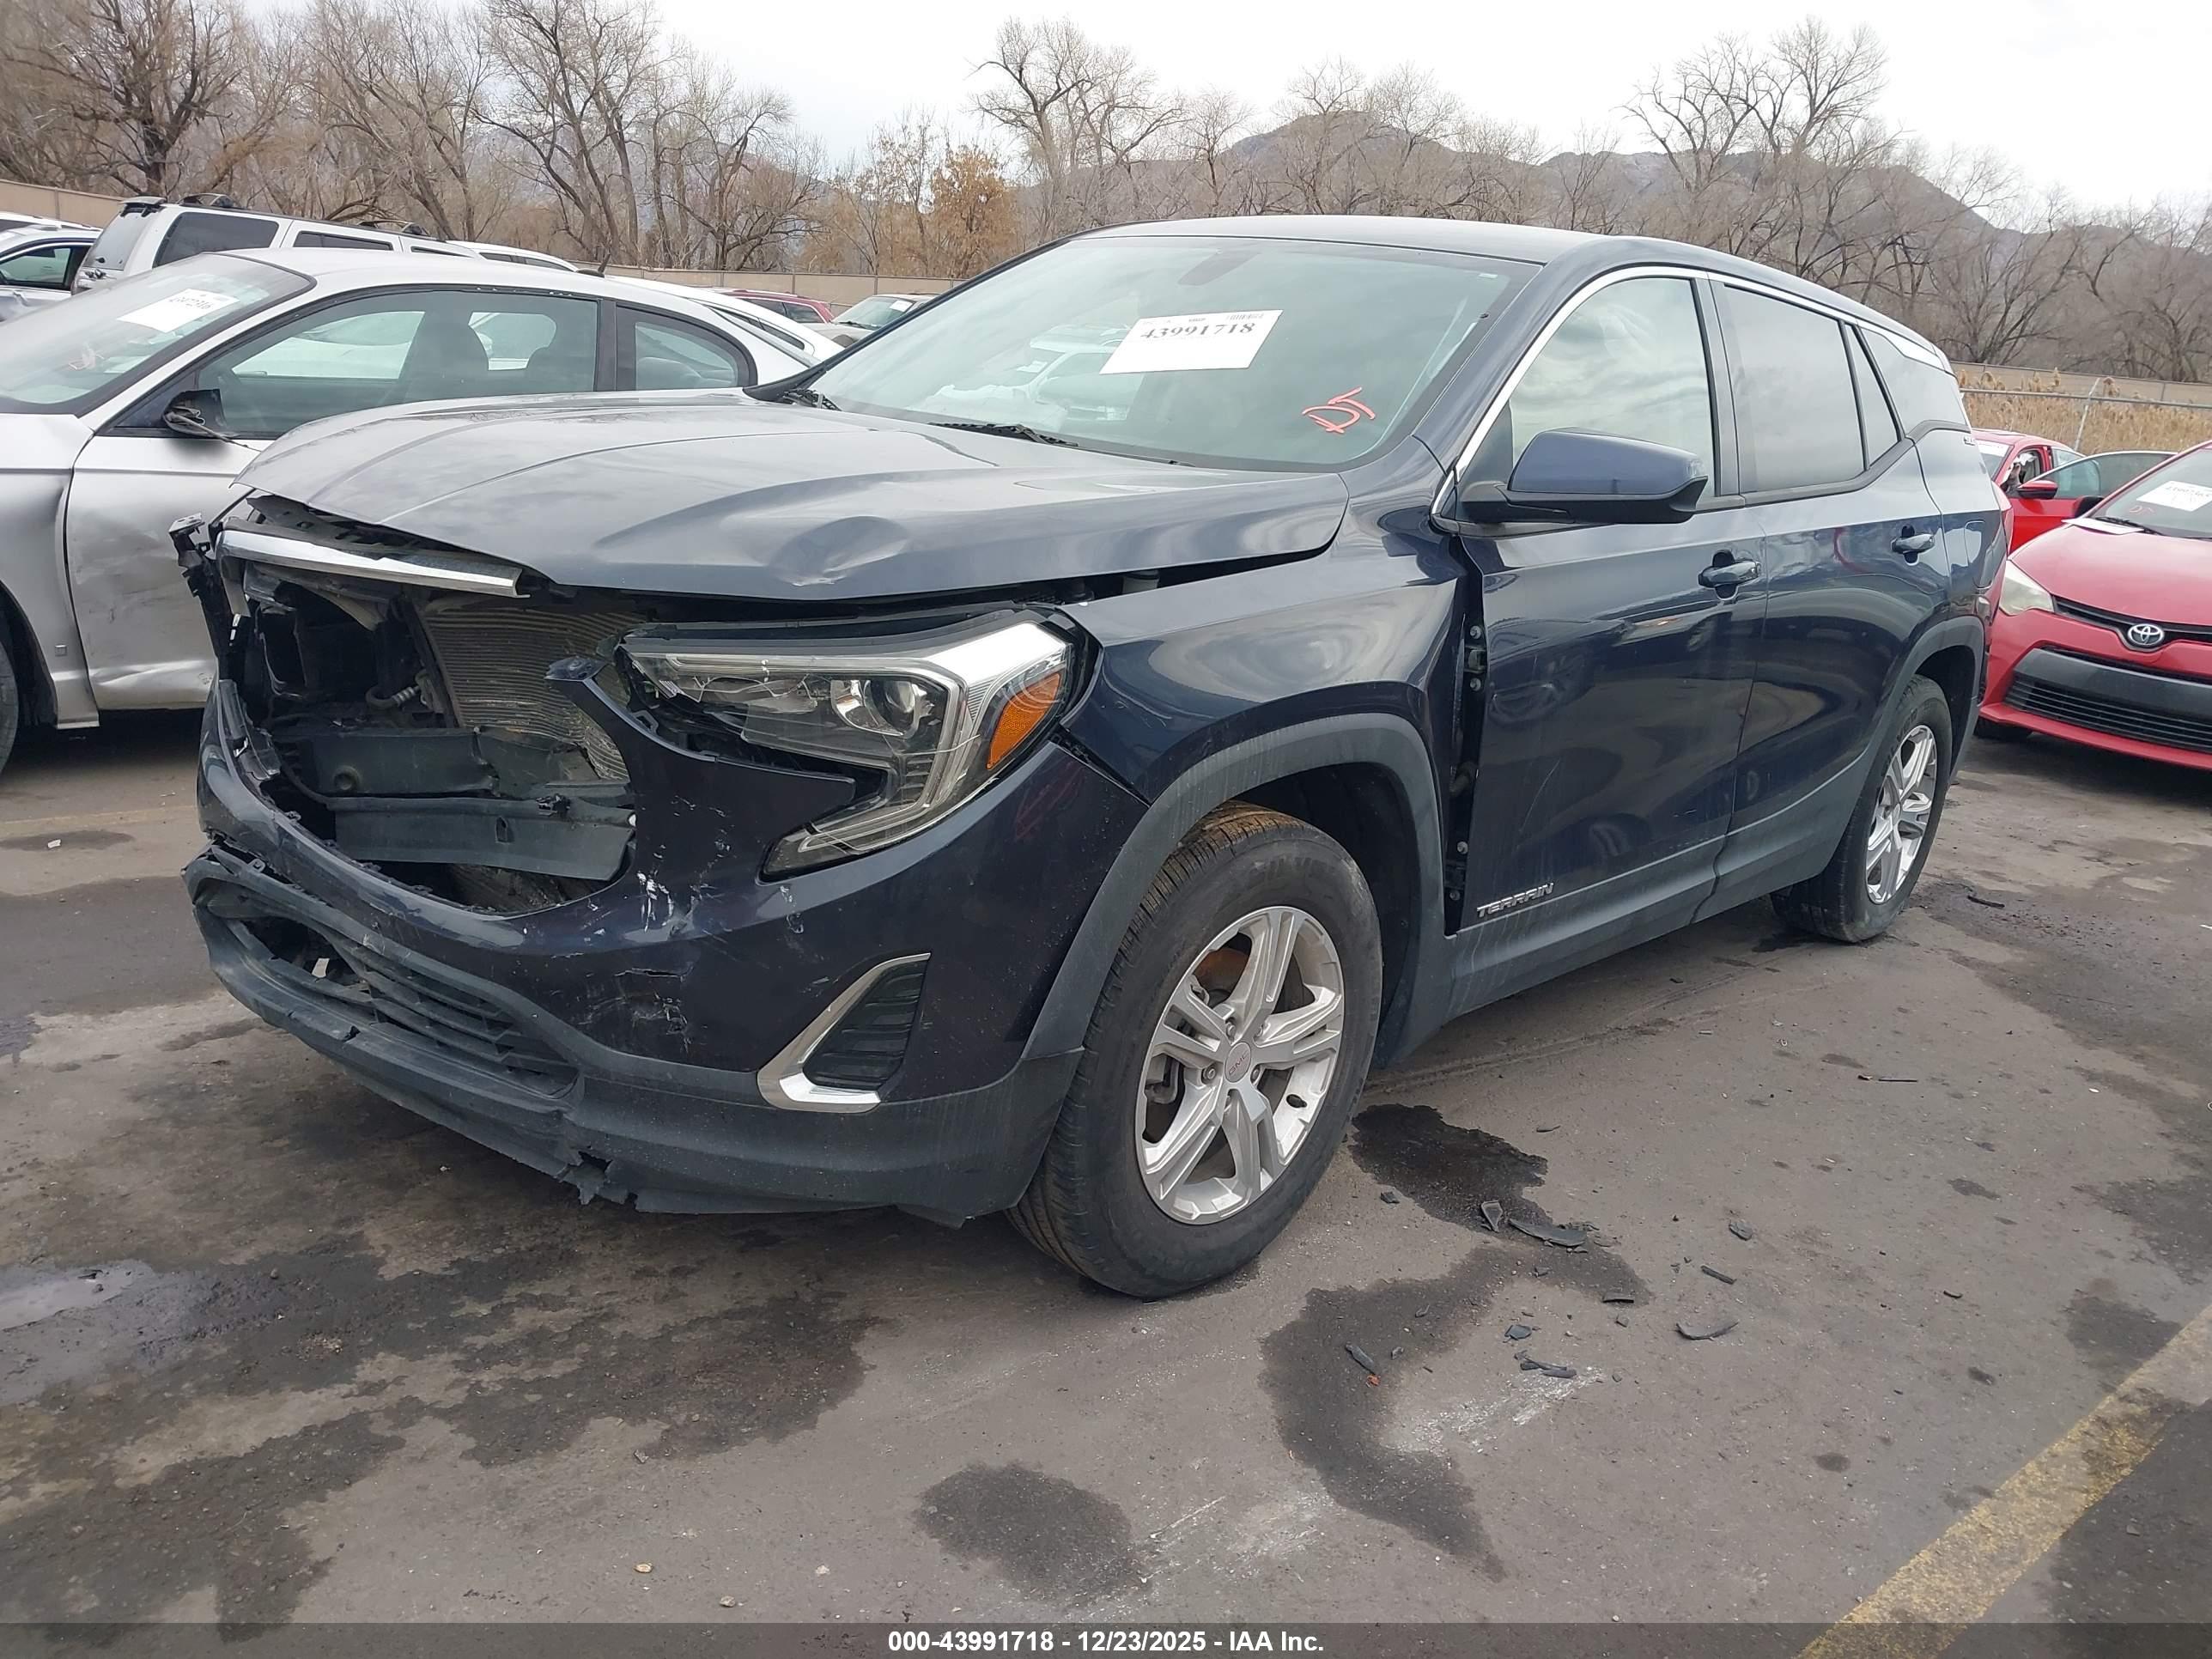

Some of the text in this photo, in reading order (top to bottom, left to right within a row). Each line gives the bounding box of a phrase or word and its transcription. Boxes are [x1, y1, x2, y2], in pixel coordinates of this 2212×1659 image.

[1139, 322, 1256, 339] 43991718
[1476, 882, 1555, 918] TERRAIN
[1228, 1048, 1249, 1077] GMC
